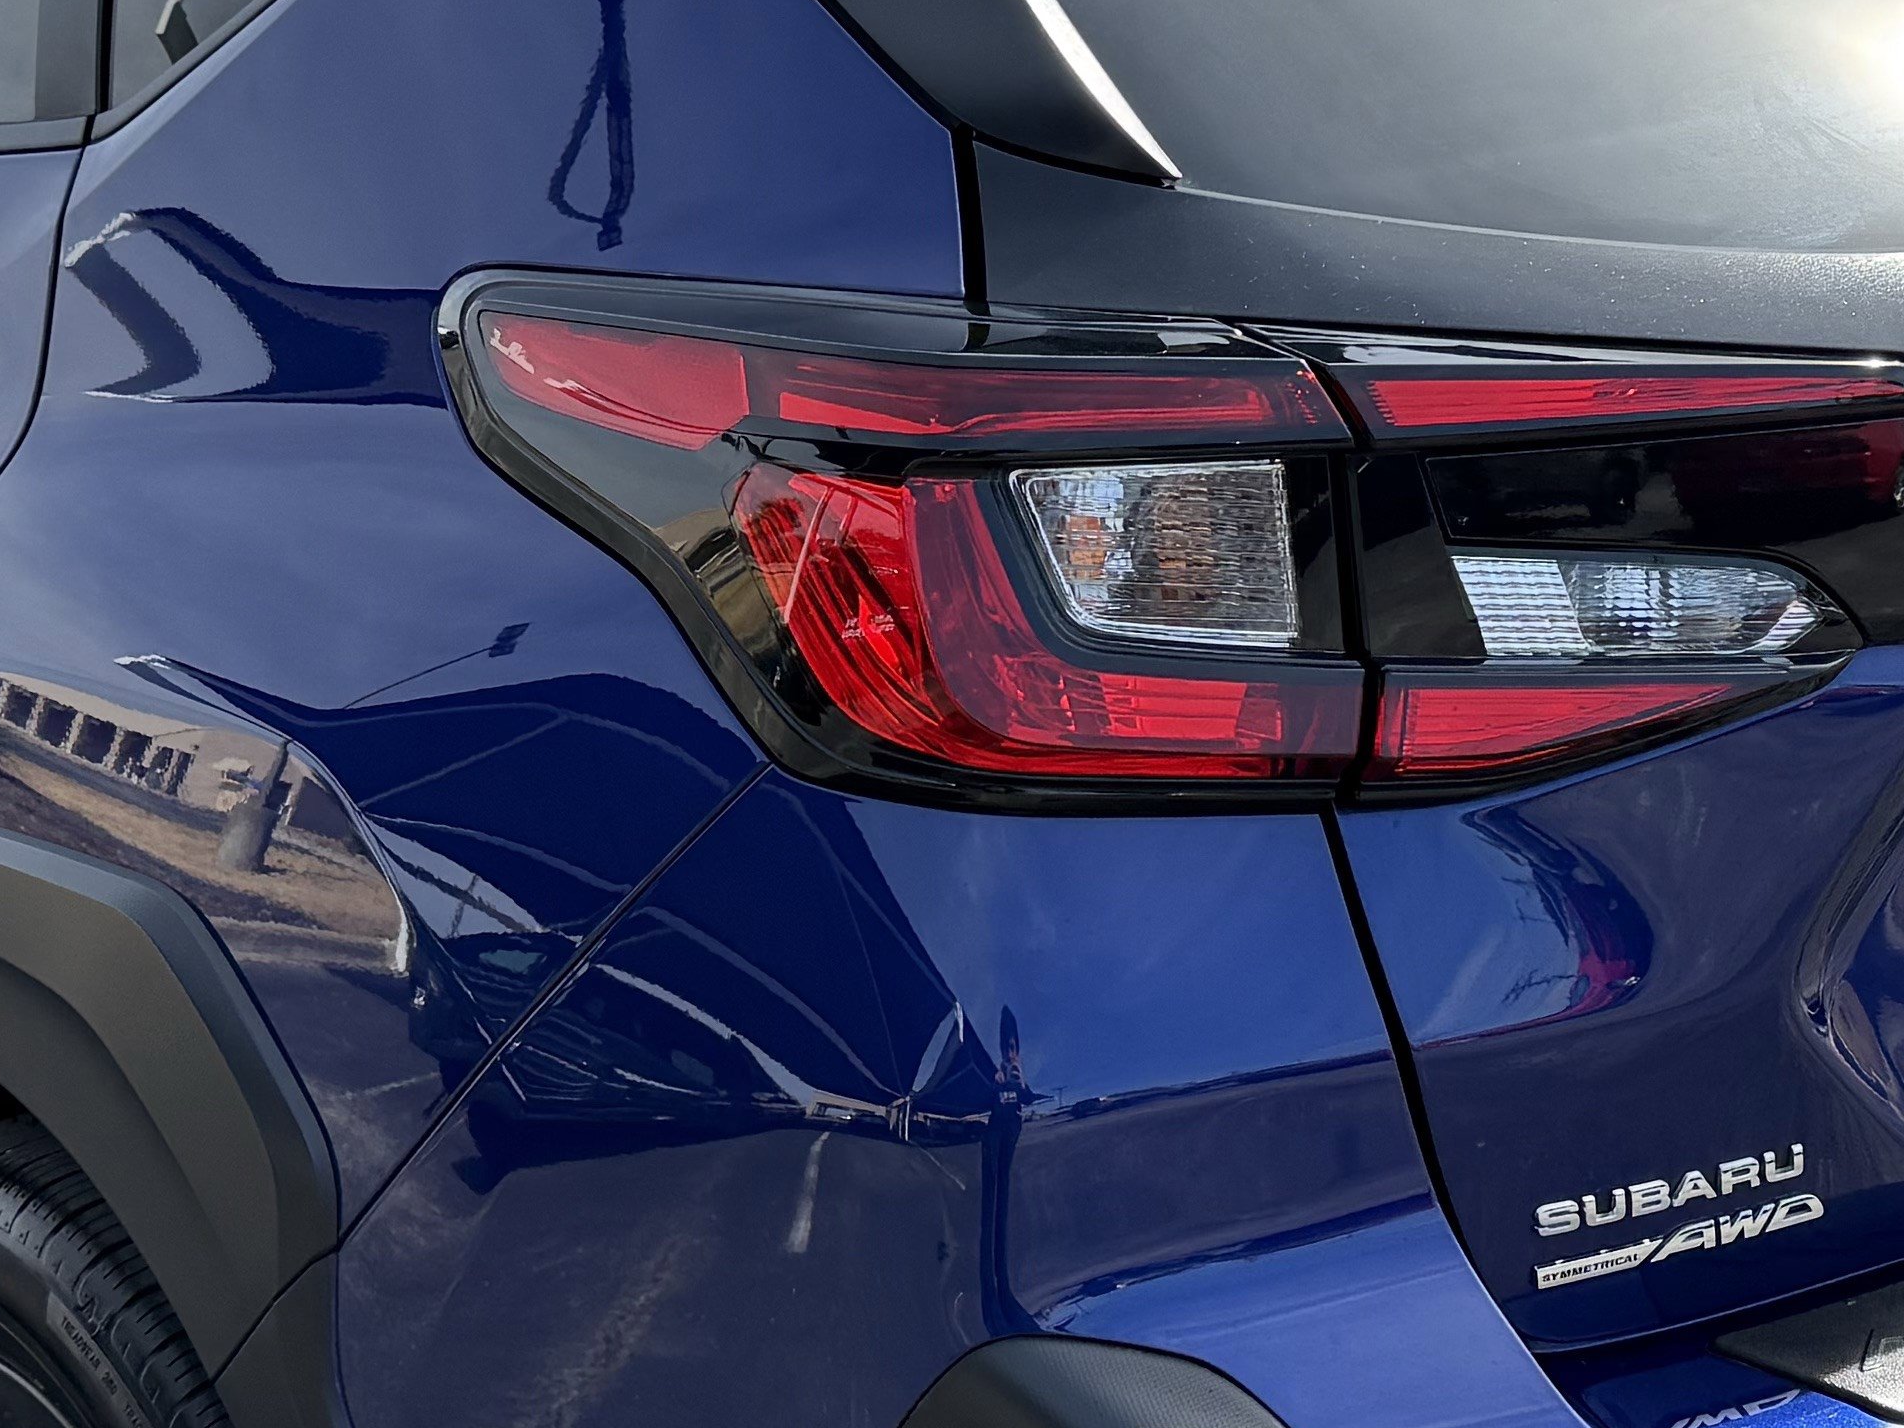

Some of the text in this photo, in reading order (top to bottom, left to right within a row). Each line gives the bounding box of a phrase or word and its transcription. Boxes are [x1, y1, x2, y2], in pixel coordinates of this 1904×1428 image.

[1534, 1143, 1805, 1237] SUBARU
[1541, 1193, 1825, 1283] SYMMETRICAL AWD
